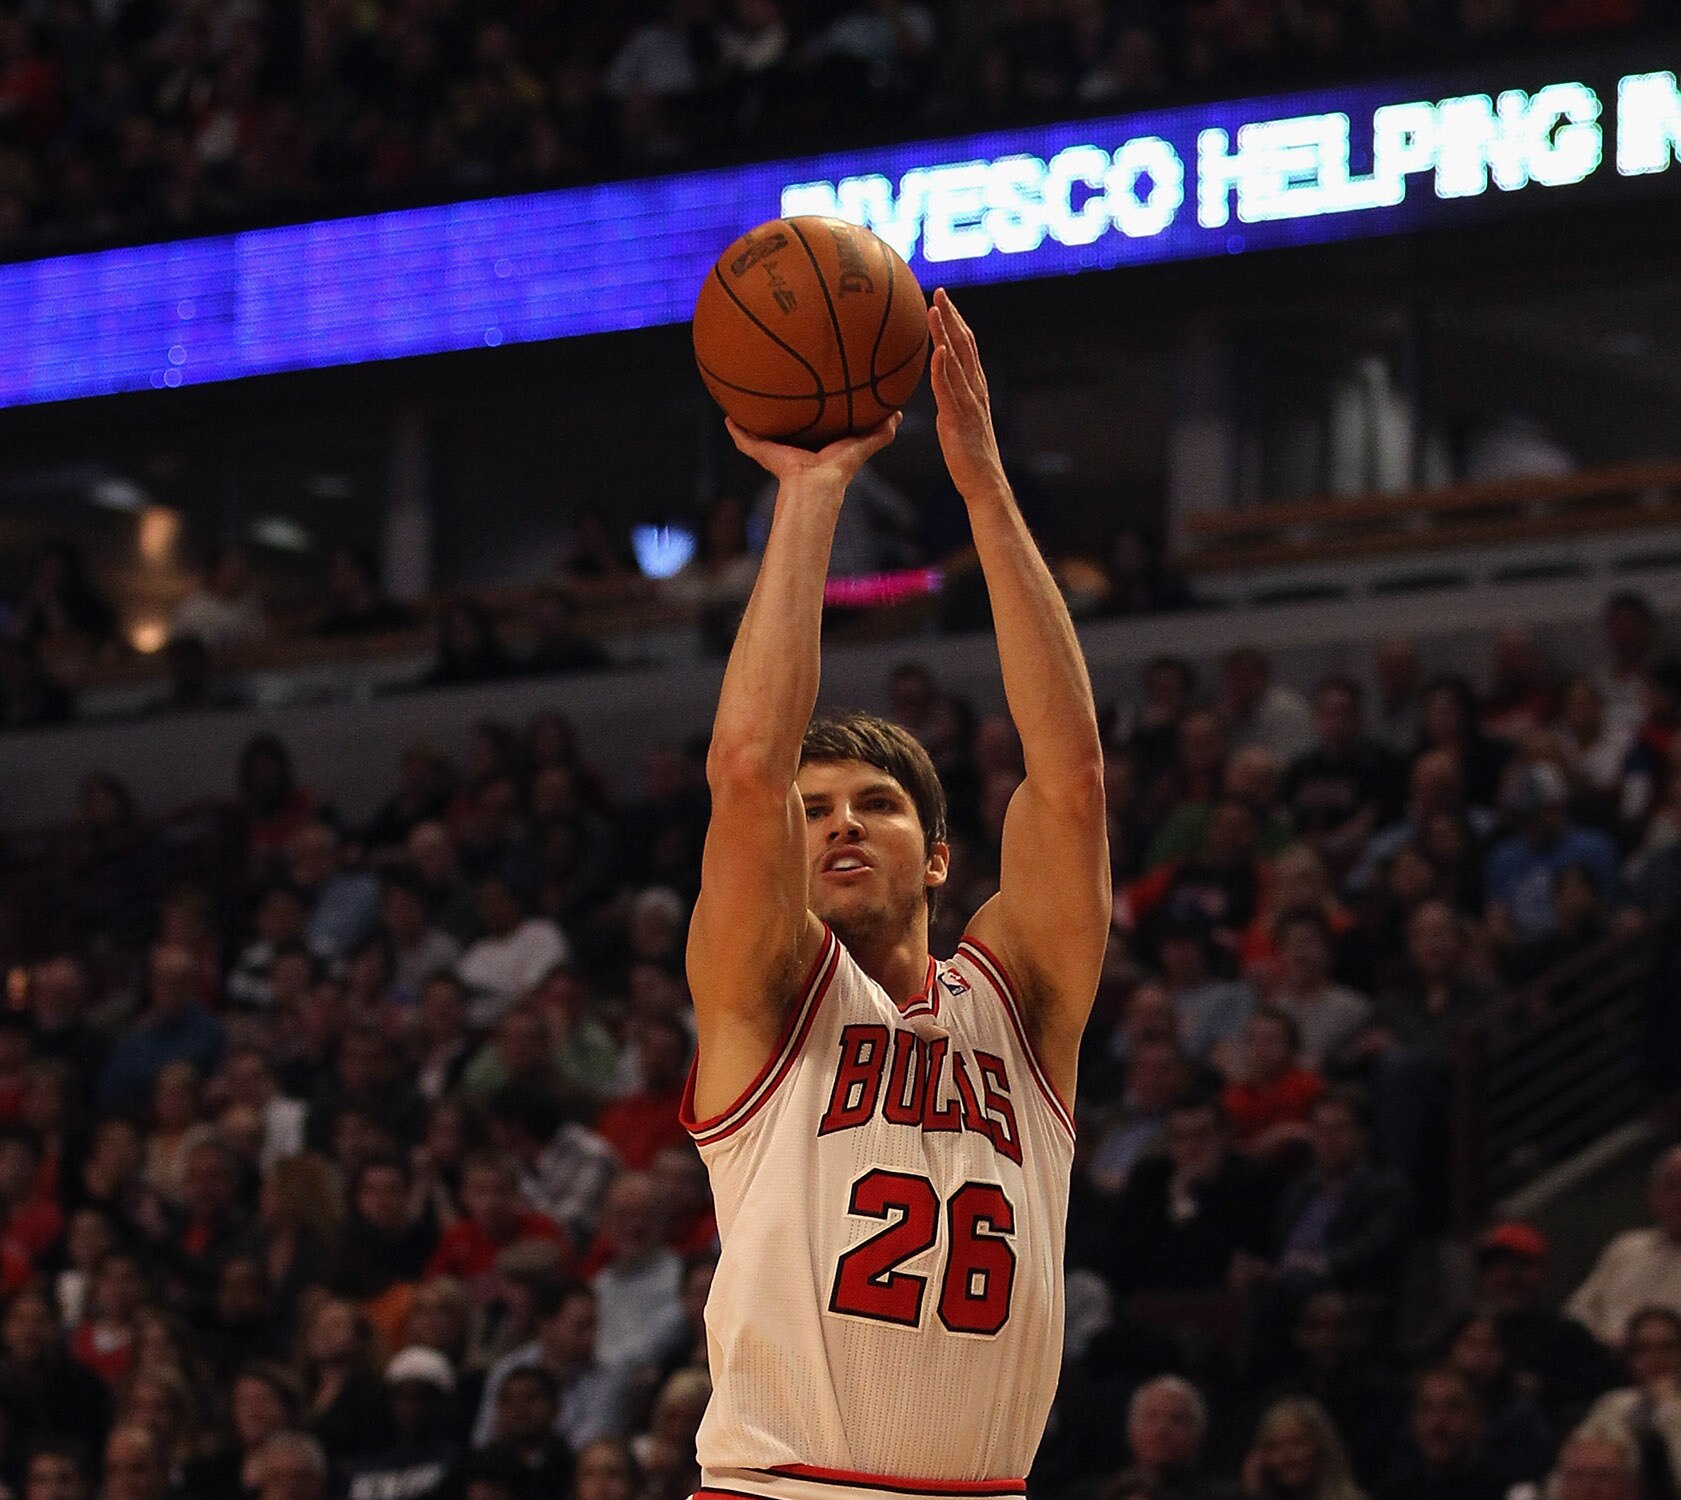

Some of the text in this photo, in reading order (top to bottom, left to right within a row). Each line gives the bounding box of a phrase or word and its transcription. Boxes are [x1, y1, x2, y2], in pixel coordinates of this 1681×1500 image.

[1197, 82, 1602, 228] HELPING
[817, 1024, 1023, 1168] BULLS
[828, 1167, 1017, 1336] 26
